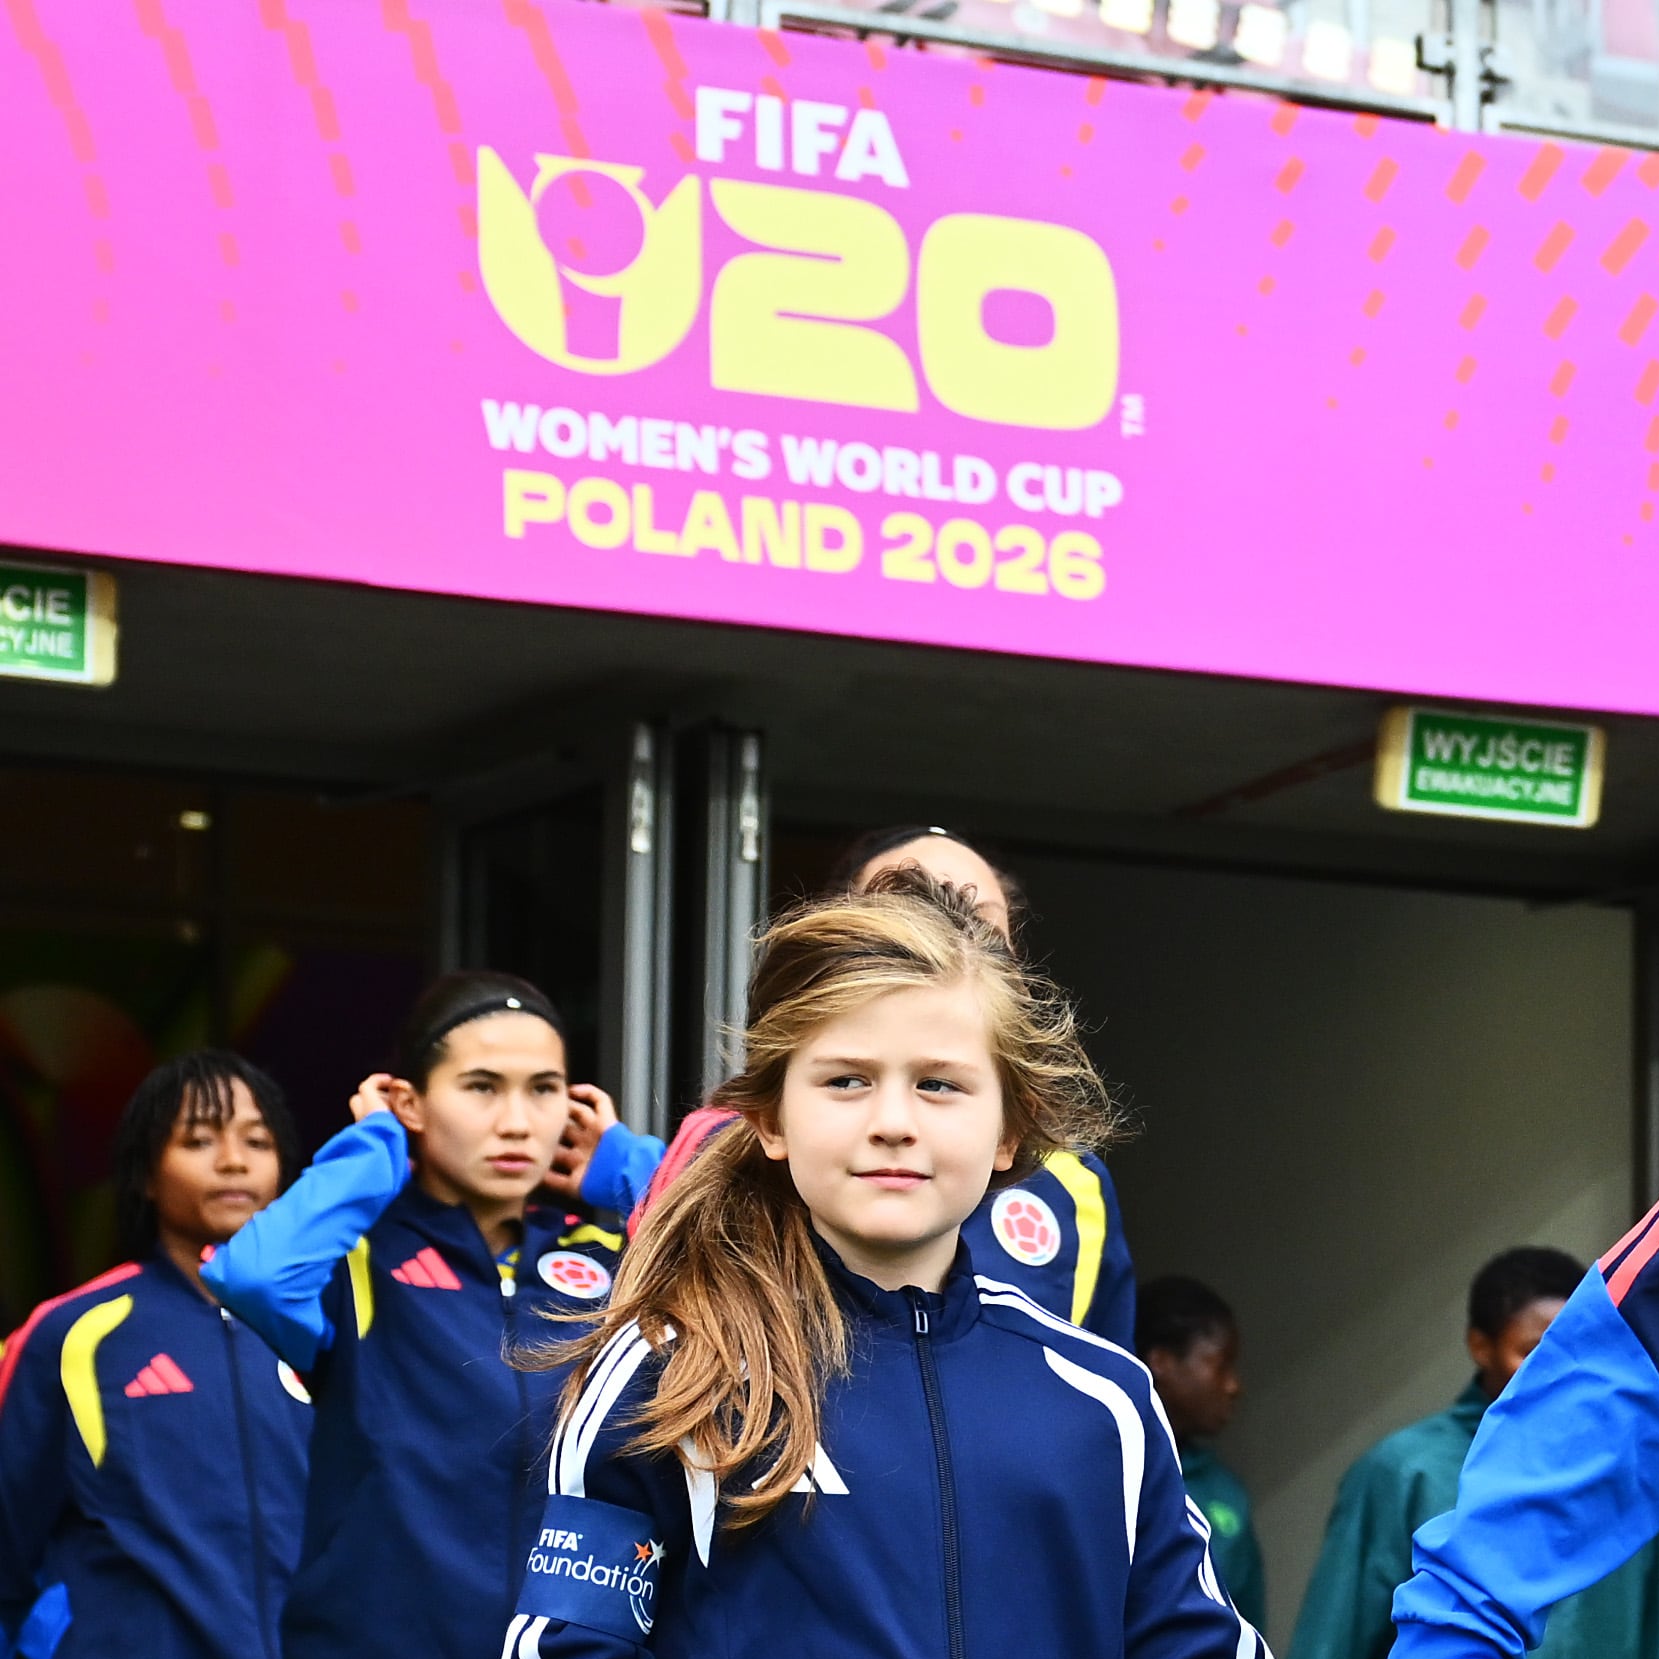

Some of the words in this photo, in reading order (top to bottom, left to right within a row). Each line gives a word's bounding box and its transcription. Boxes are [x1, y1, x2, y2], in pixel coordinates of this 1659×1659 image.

[696, 86, 909, 188] FIFA
[477, 144, 1120, 431] U20
[481, 399, 771, 480] WOMEN'S
[780, 434, 998, 506] WORLD
[1006, 462, 1123, 518] CUP
[503, 468, 863, 574] POLAND
[880, 512, 1106, 601] 2026
[1422, 728, 1576, 776] WYJŚCIE
[526, 1546, 655, 1601] Foundation
[539, 1528, 579, 1552] FIFA
